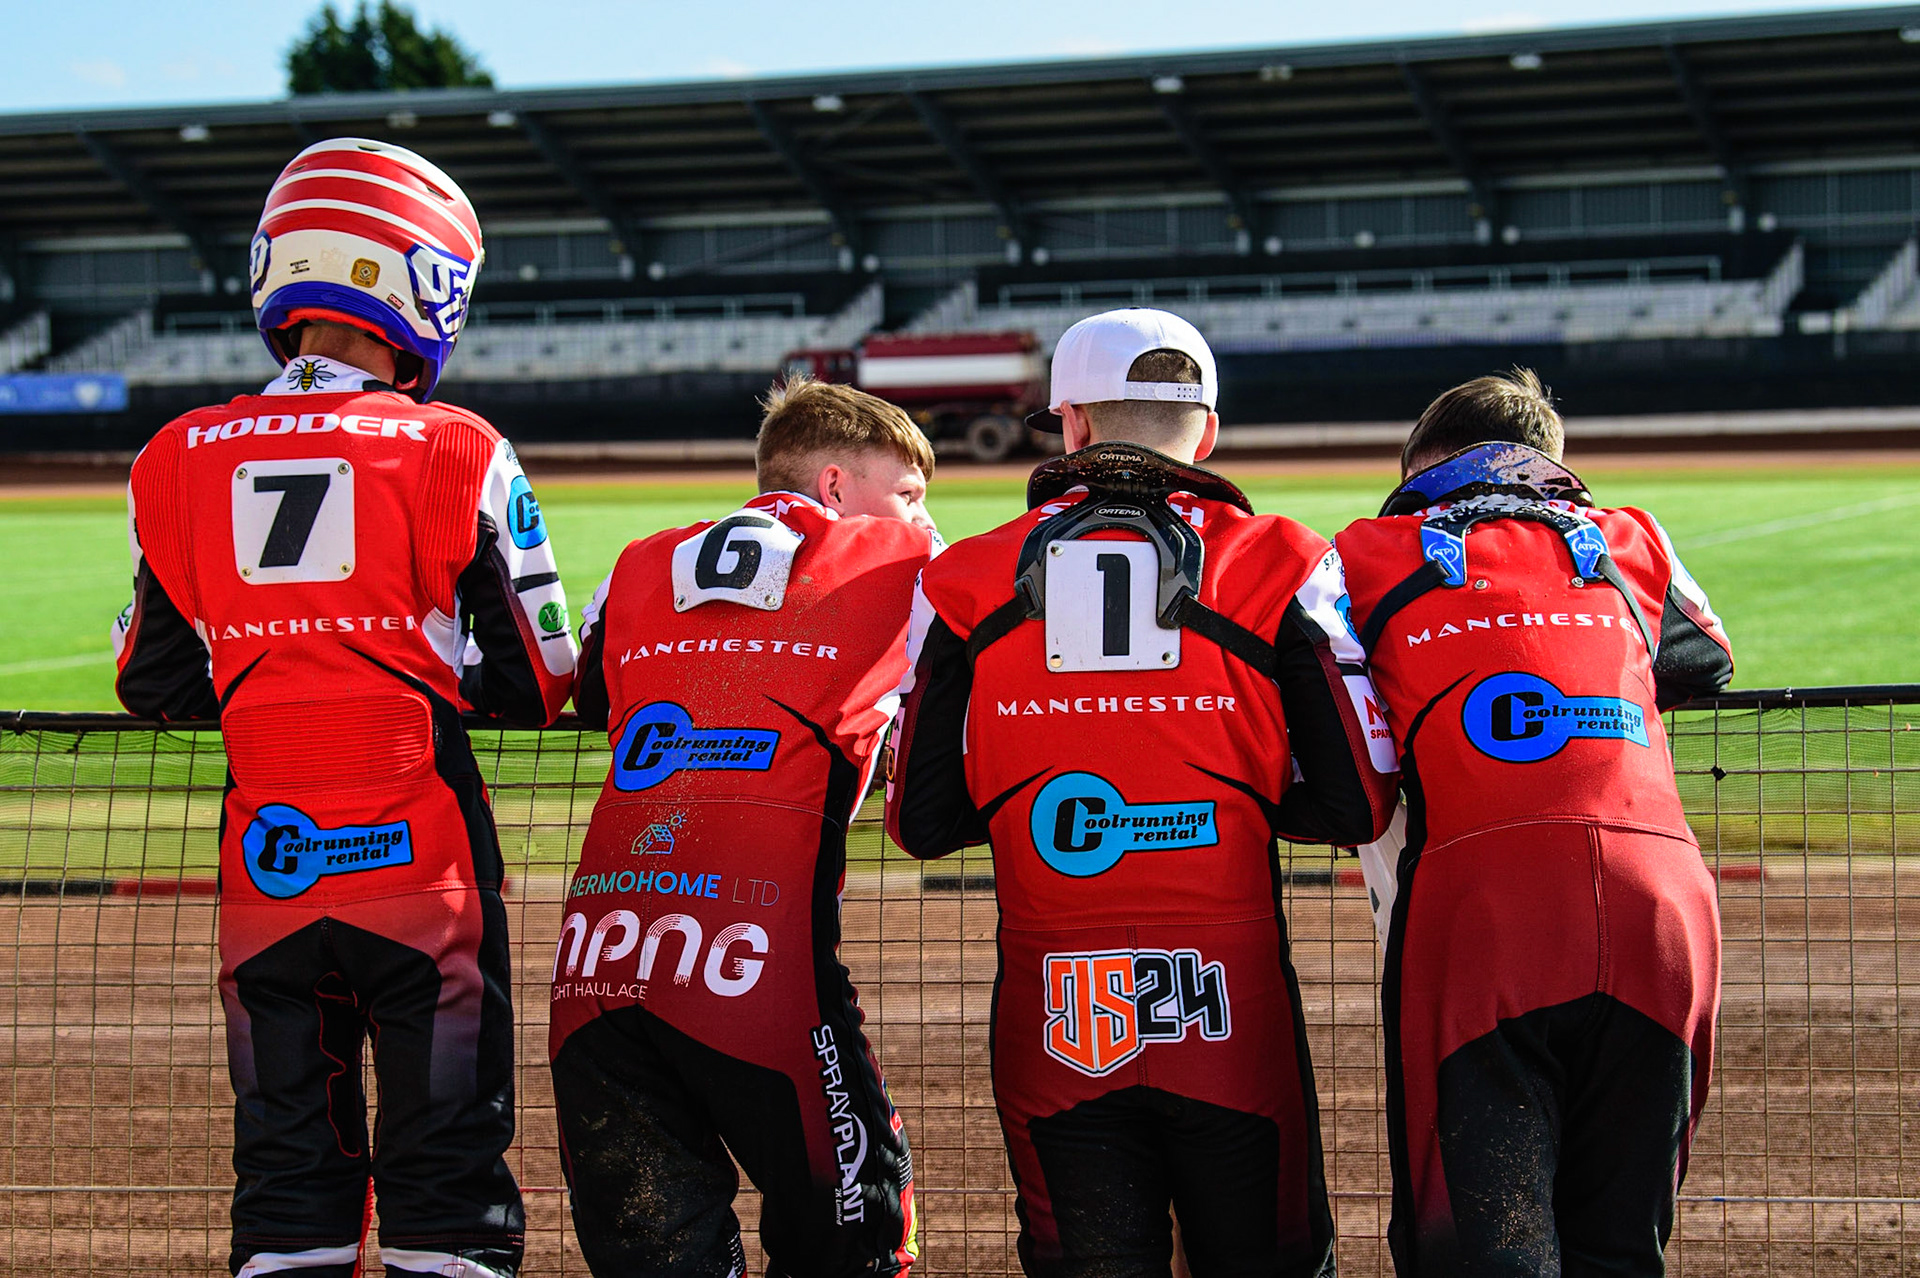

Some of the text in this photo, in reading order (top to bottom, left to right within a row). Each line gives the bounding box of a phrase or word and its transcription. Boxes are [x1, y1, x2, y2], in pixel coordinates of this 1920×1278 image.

[187, 413, 427, 449] HODDER
[1099, 453, 1142, 462] ORTEMA
[254, 474, 330, 567] 7
[1098, 508, 1141, 516] ORTEMA
[695, 515, 774, 590] 6
[1433, 547, 1455, 556] ATPI
[1097, 553, 1130, 656] 1
[997, 695, 1236, 716] MANCHESTER
[1490, 691, 1642, 741] Coolrunning
[1576, 717, 1635, 735] rental
[622, 722, 771, 771] Coolrunning
[687, 749, 754, 763] rental
[1053, 797, 1210, 853] Coolrunning
[1133, 826, 1198, 843] rental
[257, 824, 404, 875] Coolrunning
[326, 844, 391, 866] rental
[568, 870, 781, 907] HERMOHOME LTD
[1045, 950, 1231, 1076] JS24
[813, 1024, 866, 1223] SPRAYPLANT
